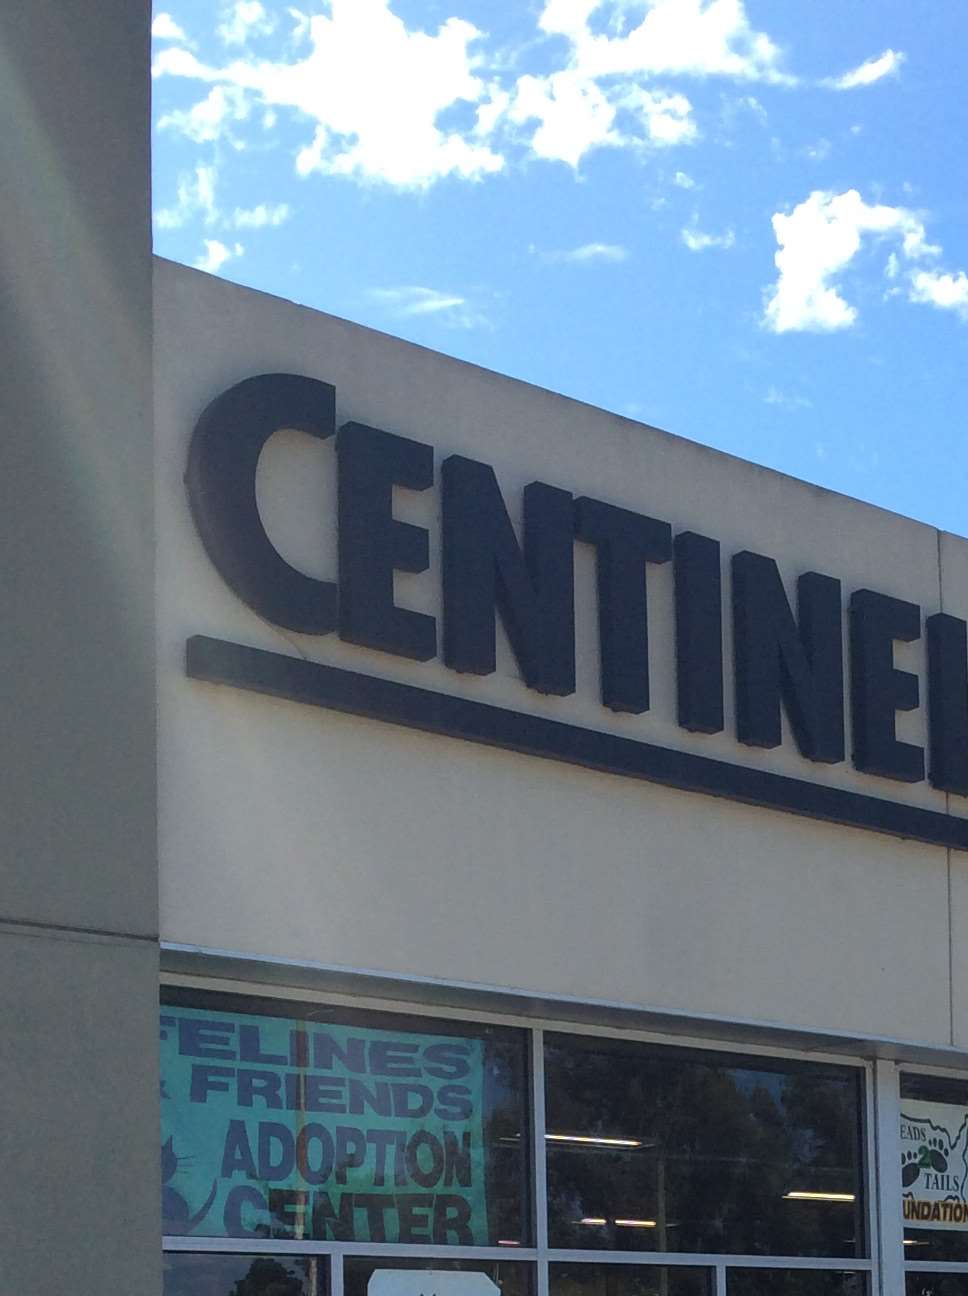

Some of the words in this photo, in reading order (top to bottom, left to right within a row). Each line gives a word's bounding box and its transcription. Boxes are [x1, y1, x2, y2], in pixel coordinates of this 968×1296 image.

[189, 1064, 474, 1121] FRIENDS
[221, 1119, 473, 1188] ADOPTION
[924, 1172, 960, 1193] TAILS
[223, 1185, 475, 1244] CENTER
